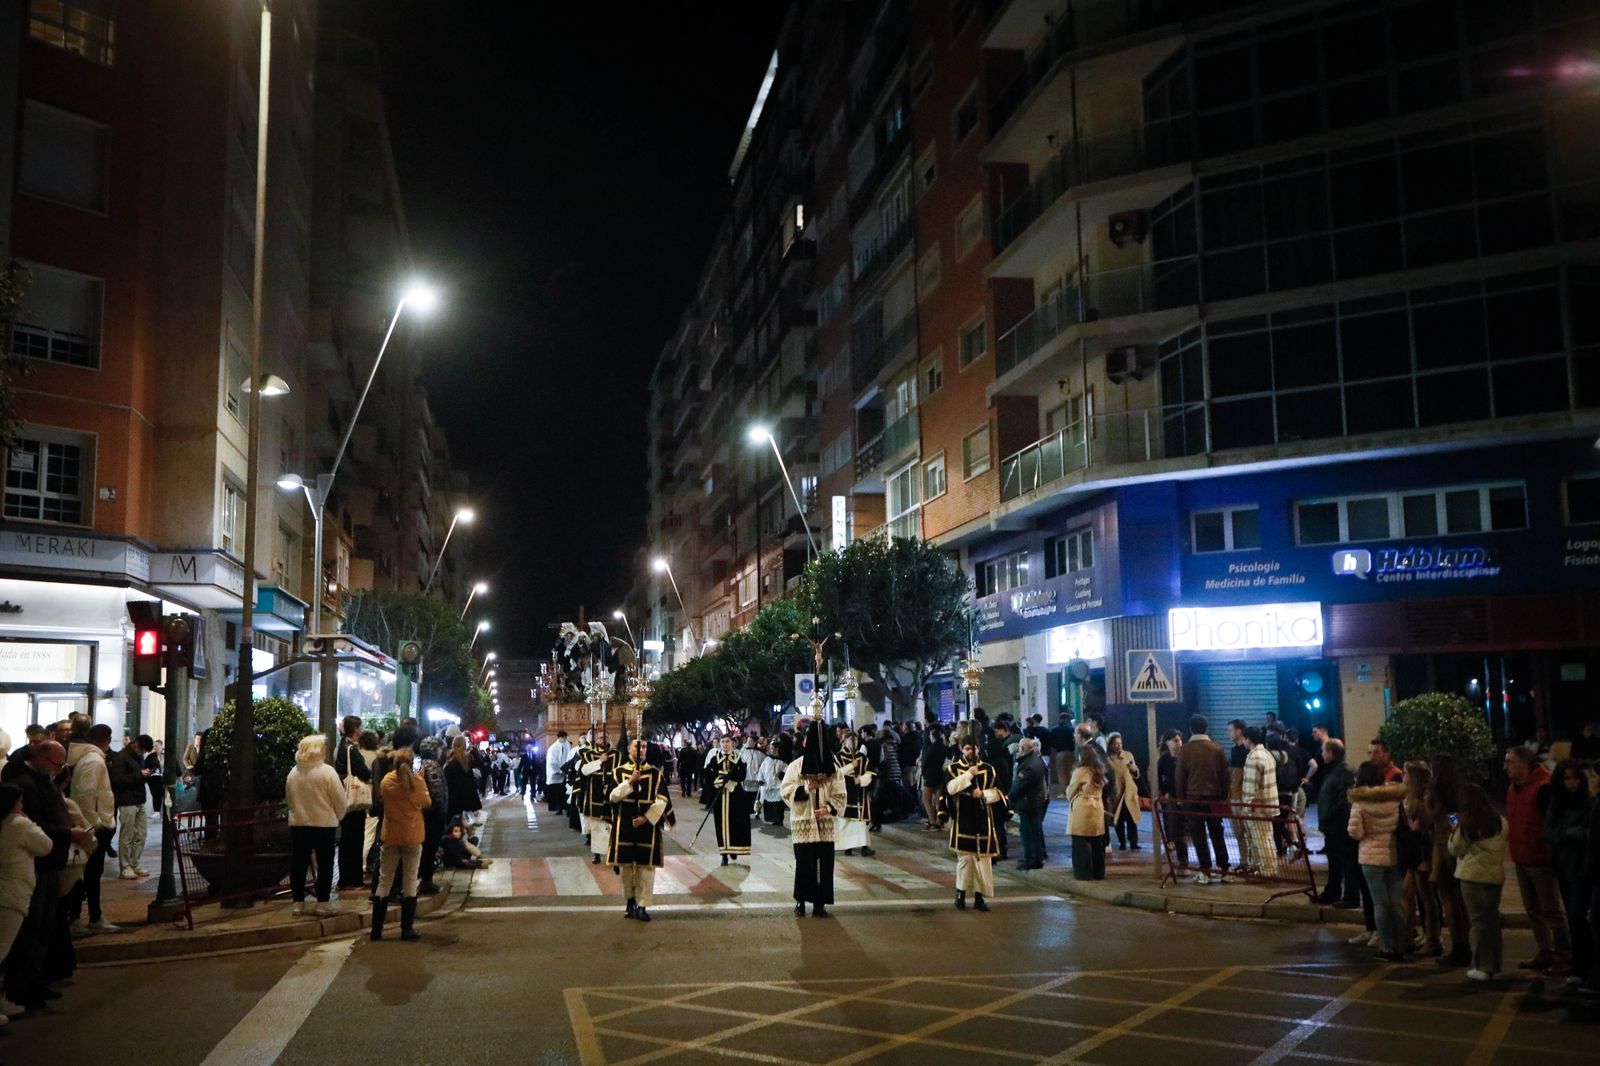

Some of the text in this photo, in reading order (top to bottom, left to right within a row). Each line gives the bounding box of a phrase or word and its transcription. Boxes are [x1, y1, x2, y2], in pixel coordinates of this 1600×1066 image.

[16, 535, 95, 558] MERAKI
[1566, 539, 1600, 552] Logo
[1228, 560, 1281, 574] Psicología
[1343, 553, 1358, 571] h
[1376, 546, 1497, 573] Háblam
[1205, 573, 1306, 590] Medicina de Familia
[1376, 566, 1502, 583] Centro Interdisciplinar
[1171, 610, 1319, 648] Phonika
